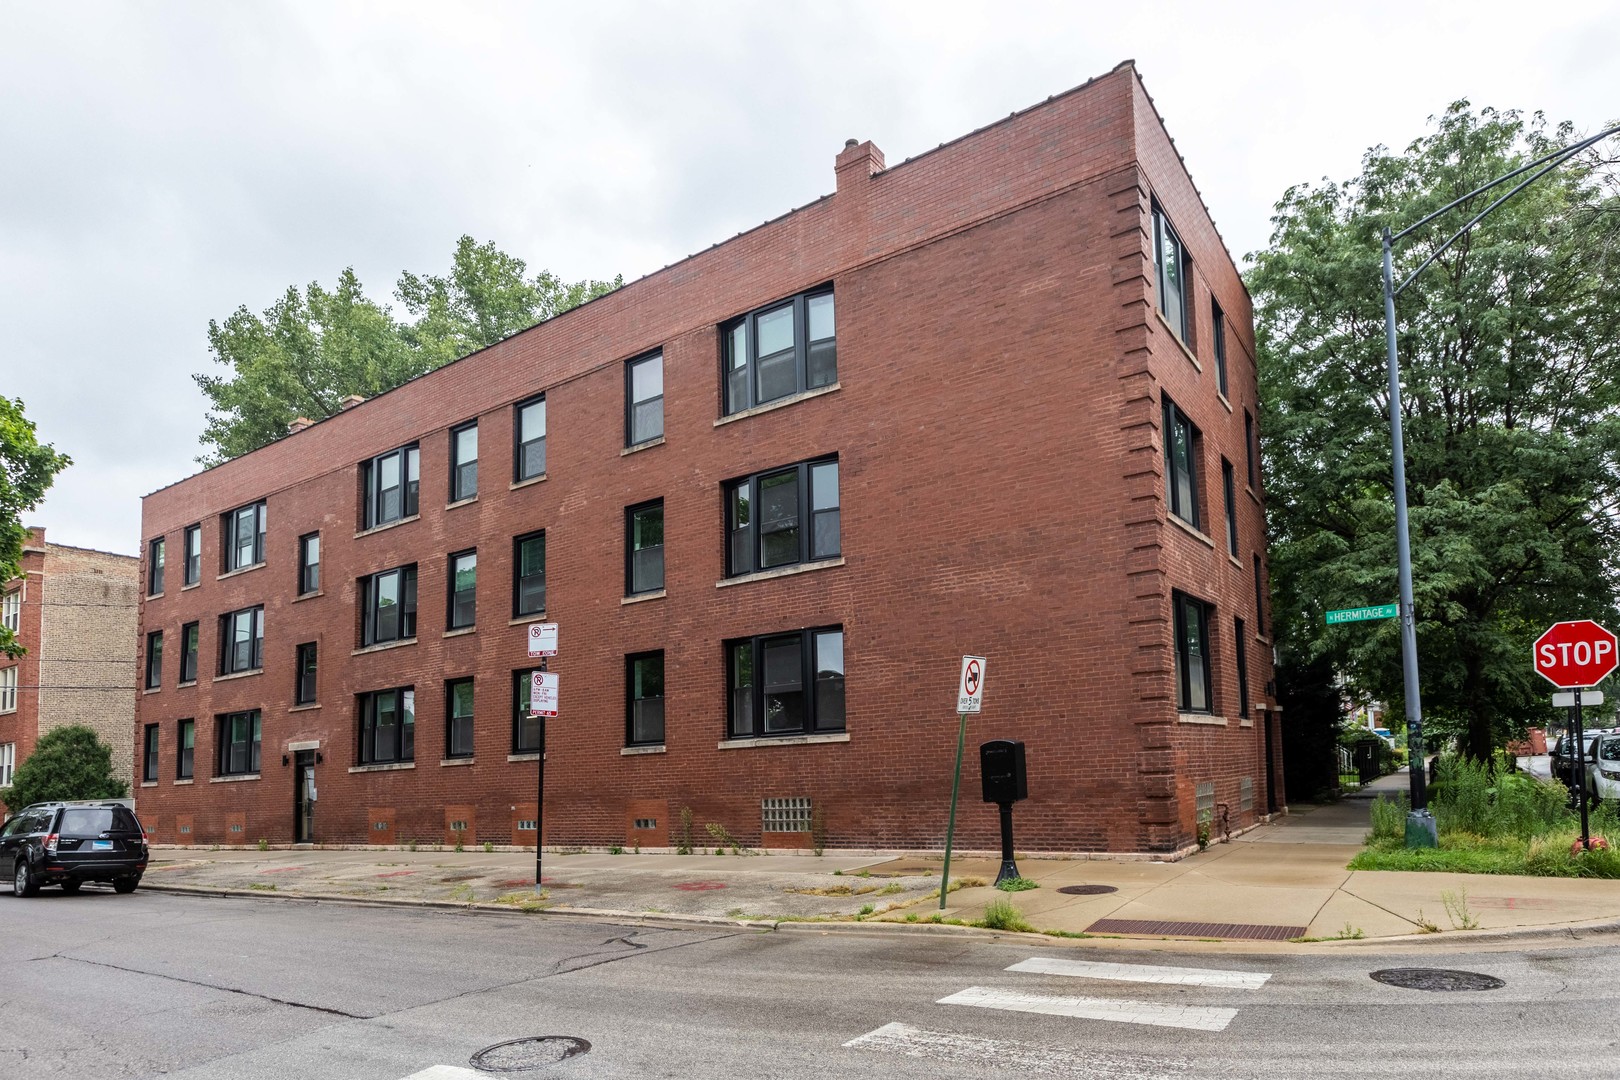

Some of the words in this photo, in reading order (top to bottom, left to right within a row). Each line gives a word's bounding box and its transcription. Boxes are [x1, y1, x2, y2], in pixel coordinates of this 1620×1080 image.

[1334, 607, 1384, 622] HERMITAGE
[1540, 640, 1612, 668] STOP
[969, 696, 972, 706] 5
